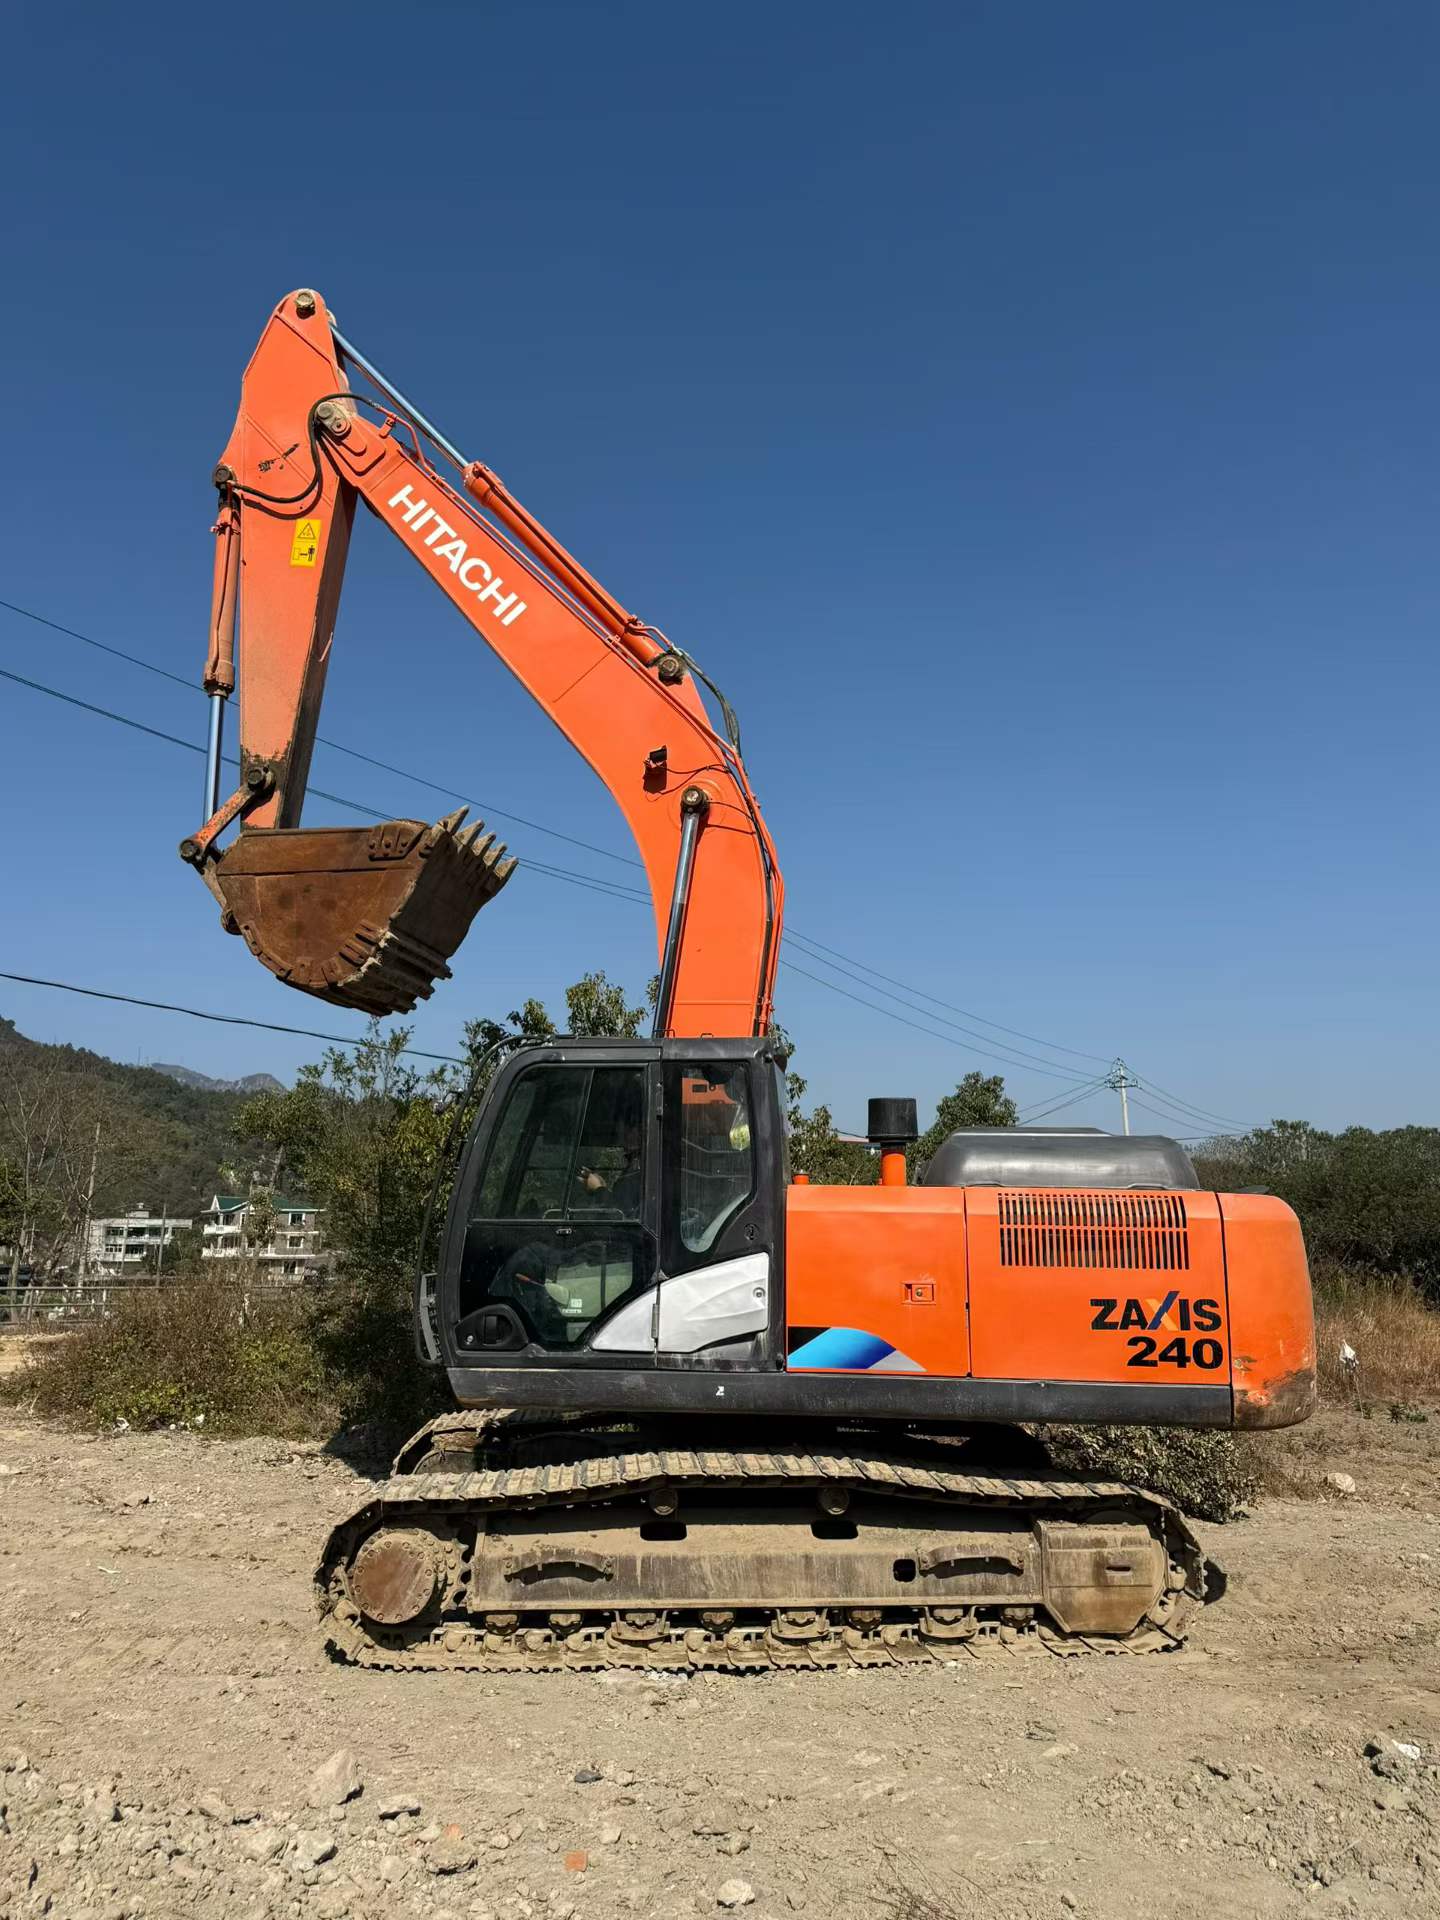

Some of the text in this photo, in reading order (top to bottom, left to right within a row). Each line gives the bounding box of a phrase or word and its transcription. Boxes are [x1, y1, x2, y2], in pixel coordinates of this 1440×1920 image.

[387, 484, 528, 626] HITACHI
[1090, 1290, 1222, 1332] ZAXIS
[1126, 1336, 1223, 1369] 240
